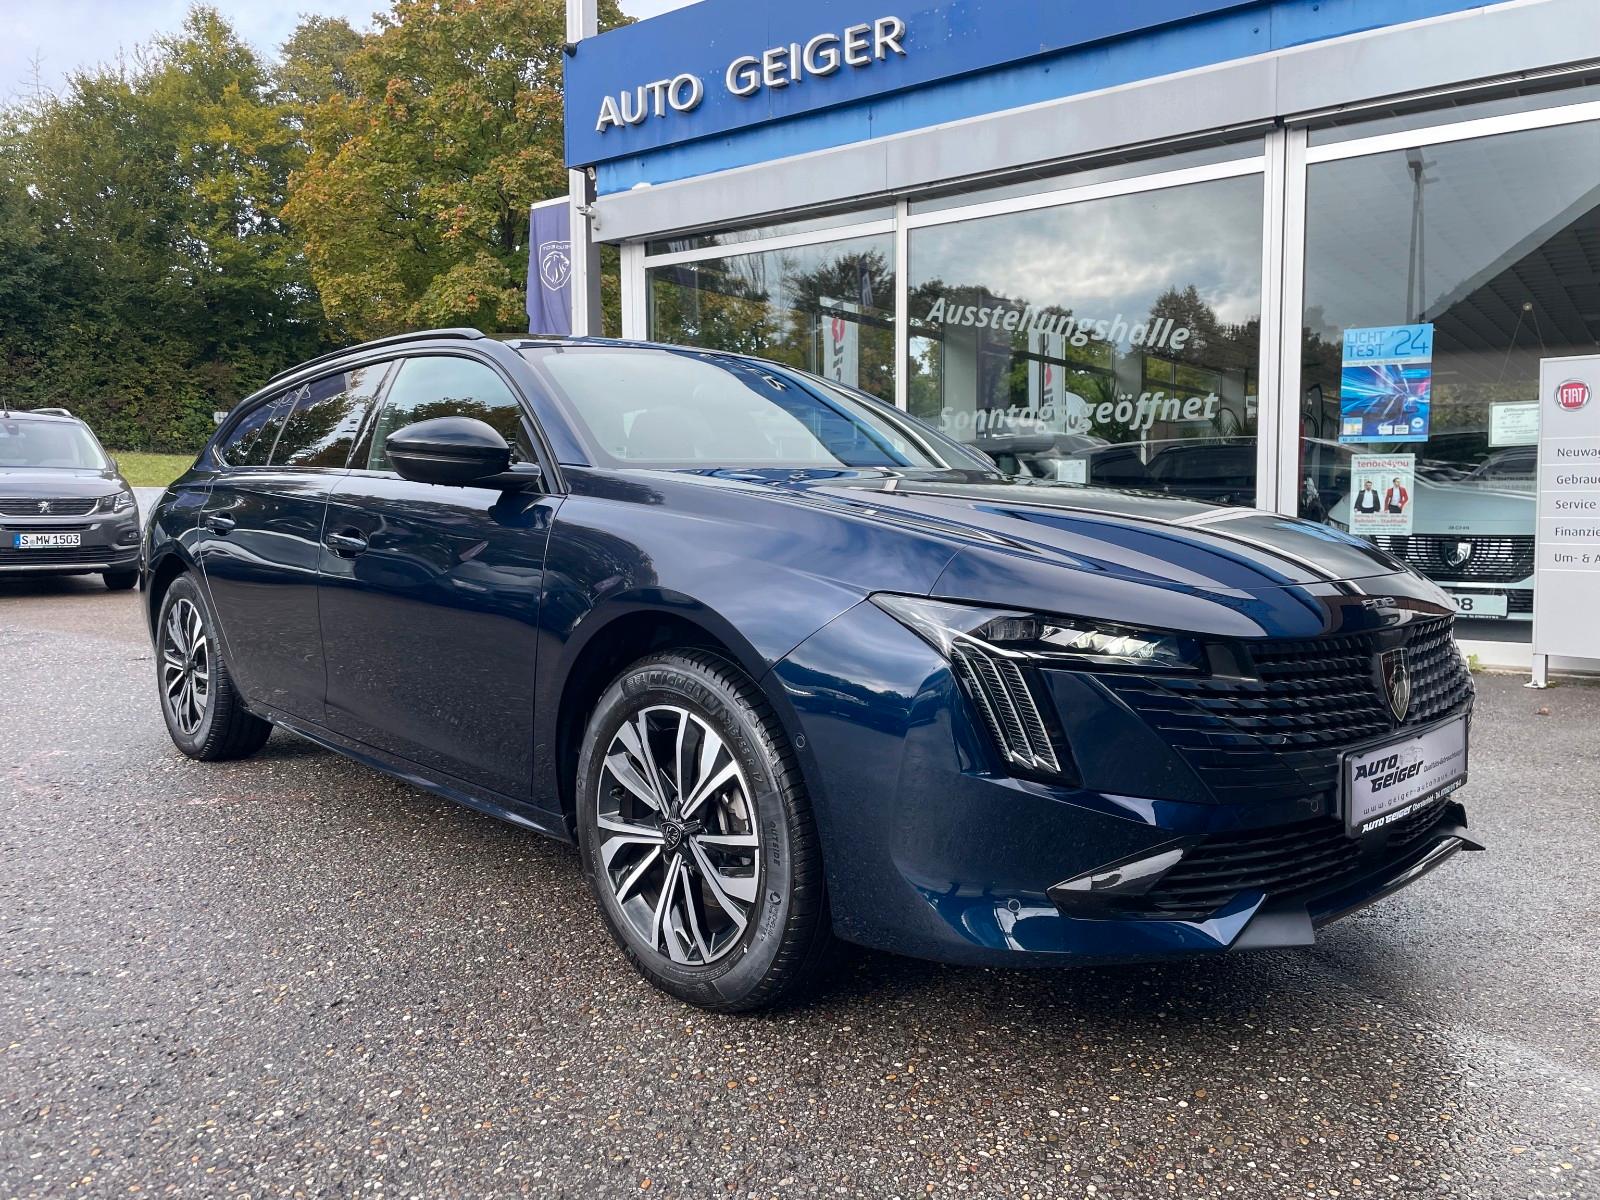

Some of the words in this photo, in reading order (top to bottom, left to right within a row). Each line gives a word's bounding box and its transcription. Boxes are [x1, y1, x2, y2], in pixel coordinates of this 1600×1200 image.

[596, 73, 704, 132] AUTO
[725, 15, 907, 97] GEIGER
[926, 297, 1190, 350] Ausstellungshalle
[1346, 330, 1386, 344] LICHT
[1346, 343, 1385, 357] TEST
[1563, 387, 1584, 404] FIAT
[1076, 391, 1219, 435] geöffnet
[1555, 499, 1597, 510] Service
[21, 535, 29, 545] S
[36, 535, 50, 545] MW
[52, 534, 80, 545] 1503
[1554, 553, 1578, 563] Um-
[1582, 553, 1591, 563] &
[1354, 754, 1398, 781] AUTO
[1361, 816, 1384, 834] AUTO
